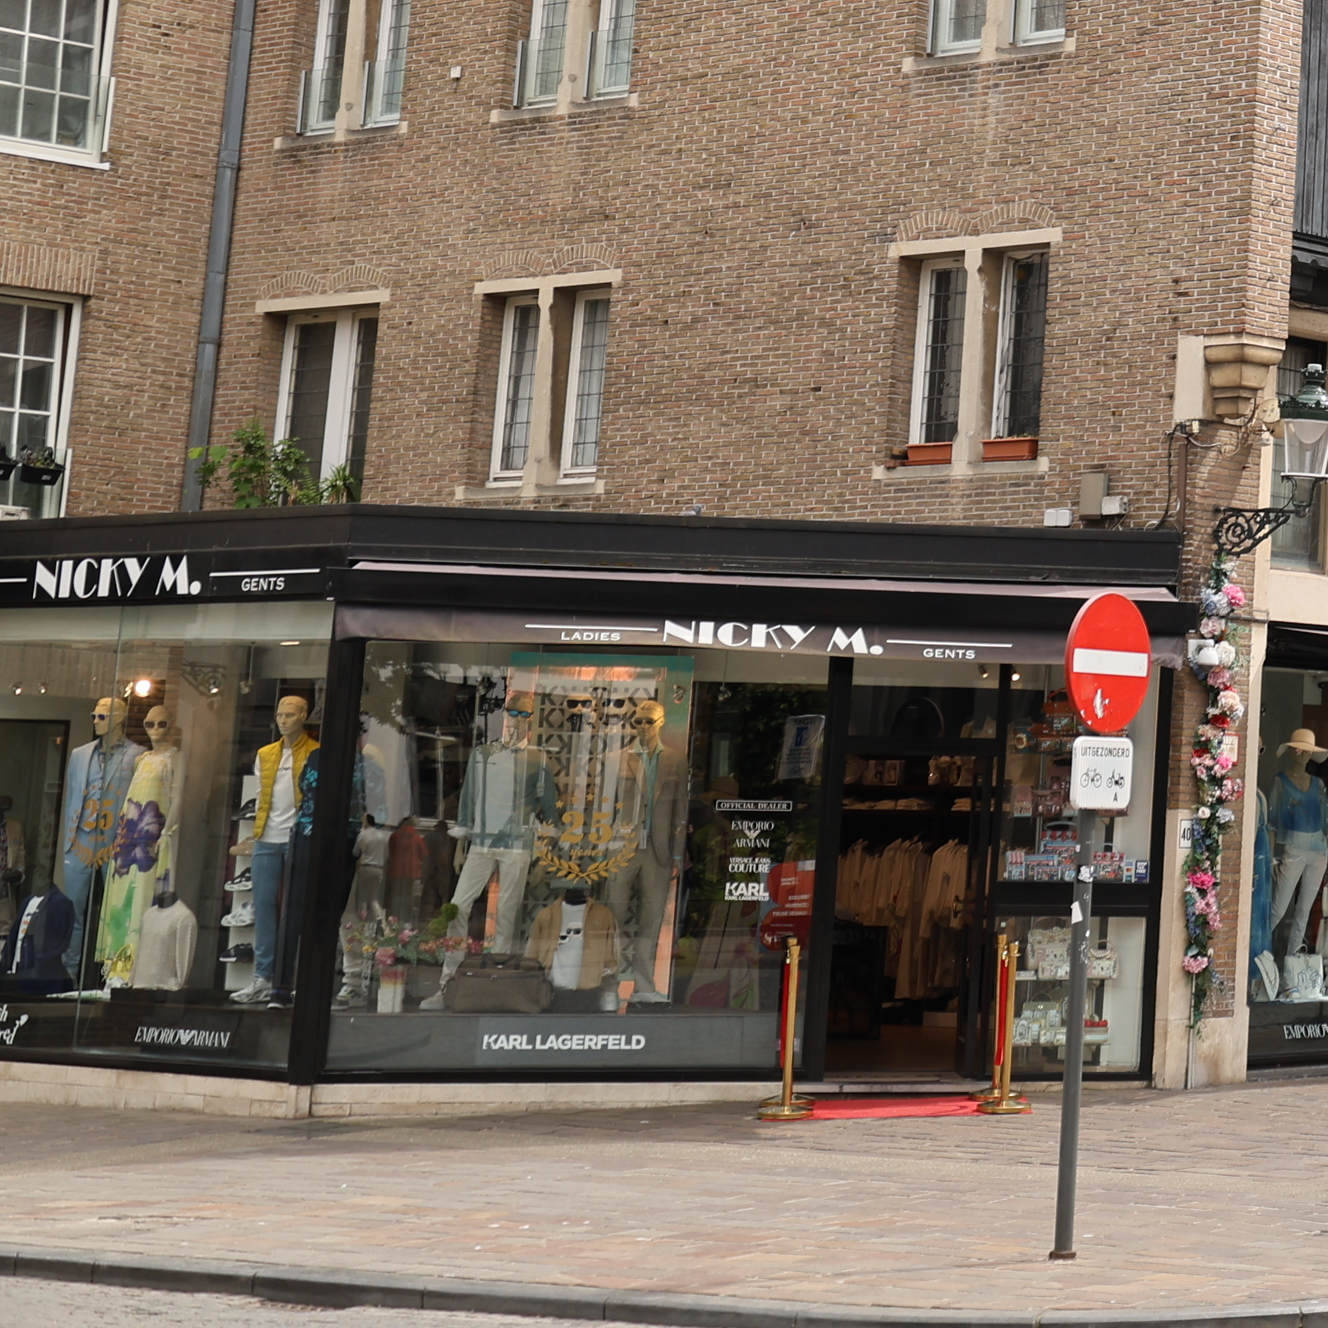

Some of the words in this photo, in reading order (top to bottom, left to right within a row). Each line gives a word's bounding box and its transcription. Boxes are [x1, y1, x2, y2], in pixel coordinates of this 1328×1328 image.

[33, 557, 151, 599] NICKY
[155, 554, 202, 595] M.
[241, 577, 286, 592] GENTS
[561, 631, 621, 642] LADIES
[662, 620, 816, 651] NICKY
[826, 626, 885, 655] M.
[922, 648, 976, 660] GENTS
[1080, 746, 1130, 758] UITGEZONDERD
[1113, 792, 1119, 802] A
[83, 799, 115, 831] 25
[560, 810, 614, 845] 25
[731, 821, 775, 831] EMPORIO
[1182, 827, 1191, 841] 40
[734, 838, 771, 849] ARMANI
[728, 863, 770, 873] COUTURE
[725, 882, 770, 896] KARL
[134, 1026, 180, 1044] EMPORIO
[191, 1029, 231, 1048] ARMANI
[1283, 1024, 1326, 1040] EMPORIO
[481, 1034, 532, 1050] KARL
[535, 1034, 646, 1050] LAGERFELD
